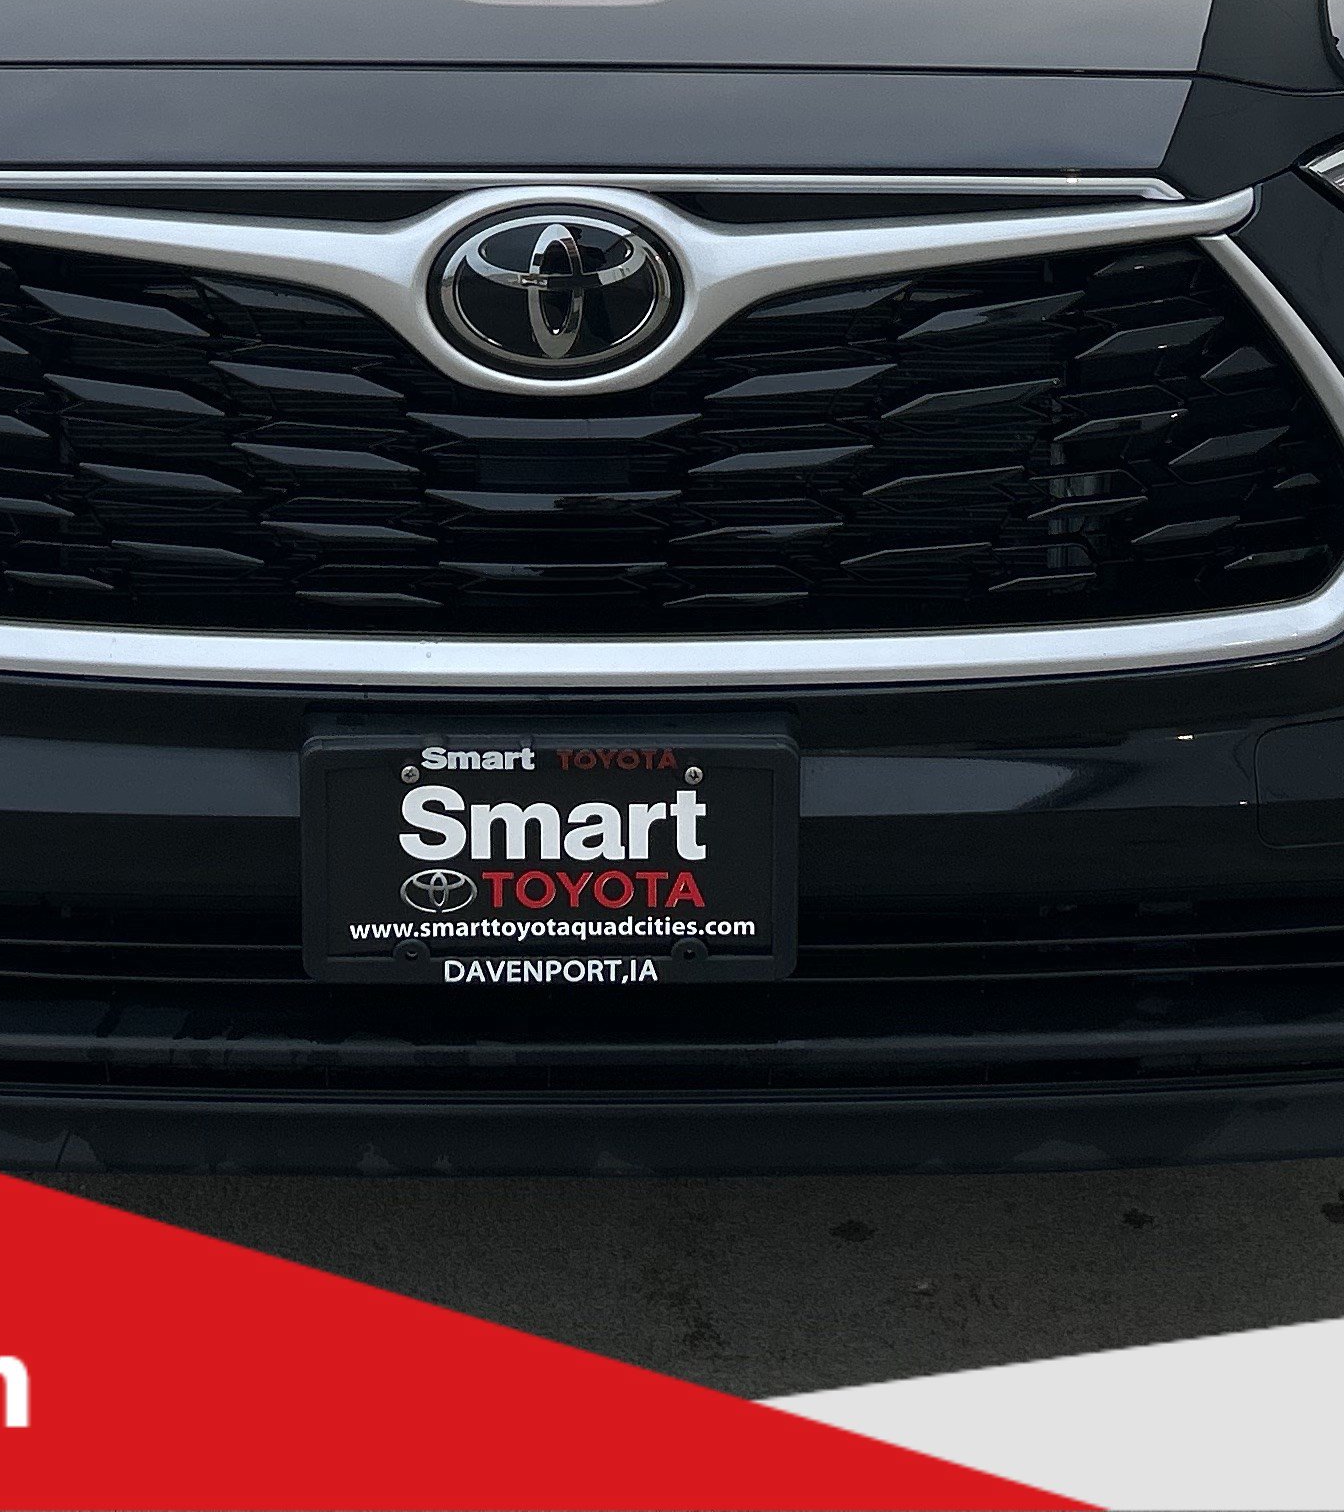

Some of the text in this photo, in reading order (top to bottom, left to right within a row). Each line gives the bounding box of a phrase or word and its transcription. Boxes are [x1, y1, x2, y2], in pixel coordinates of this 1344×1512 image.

[421, 746, 680, 772] Smart TOYOTA
[399, 785, 707, 861] Smart
[482, 870, 706, 908] TOYOTA
[349, 915, 756, 942] www.smarttoyotaquadcities.com
[443, 958, 659, 985] DAVENPORT,IA
